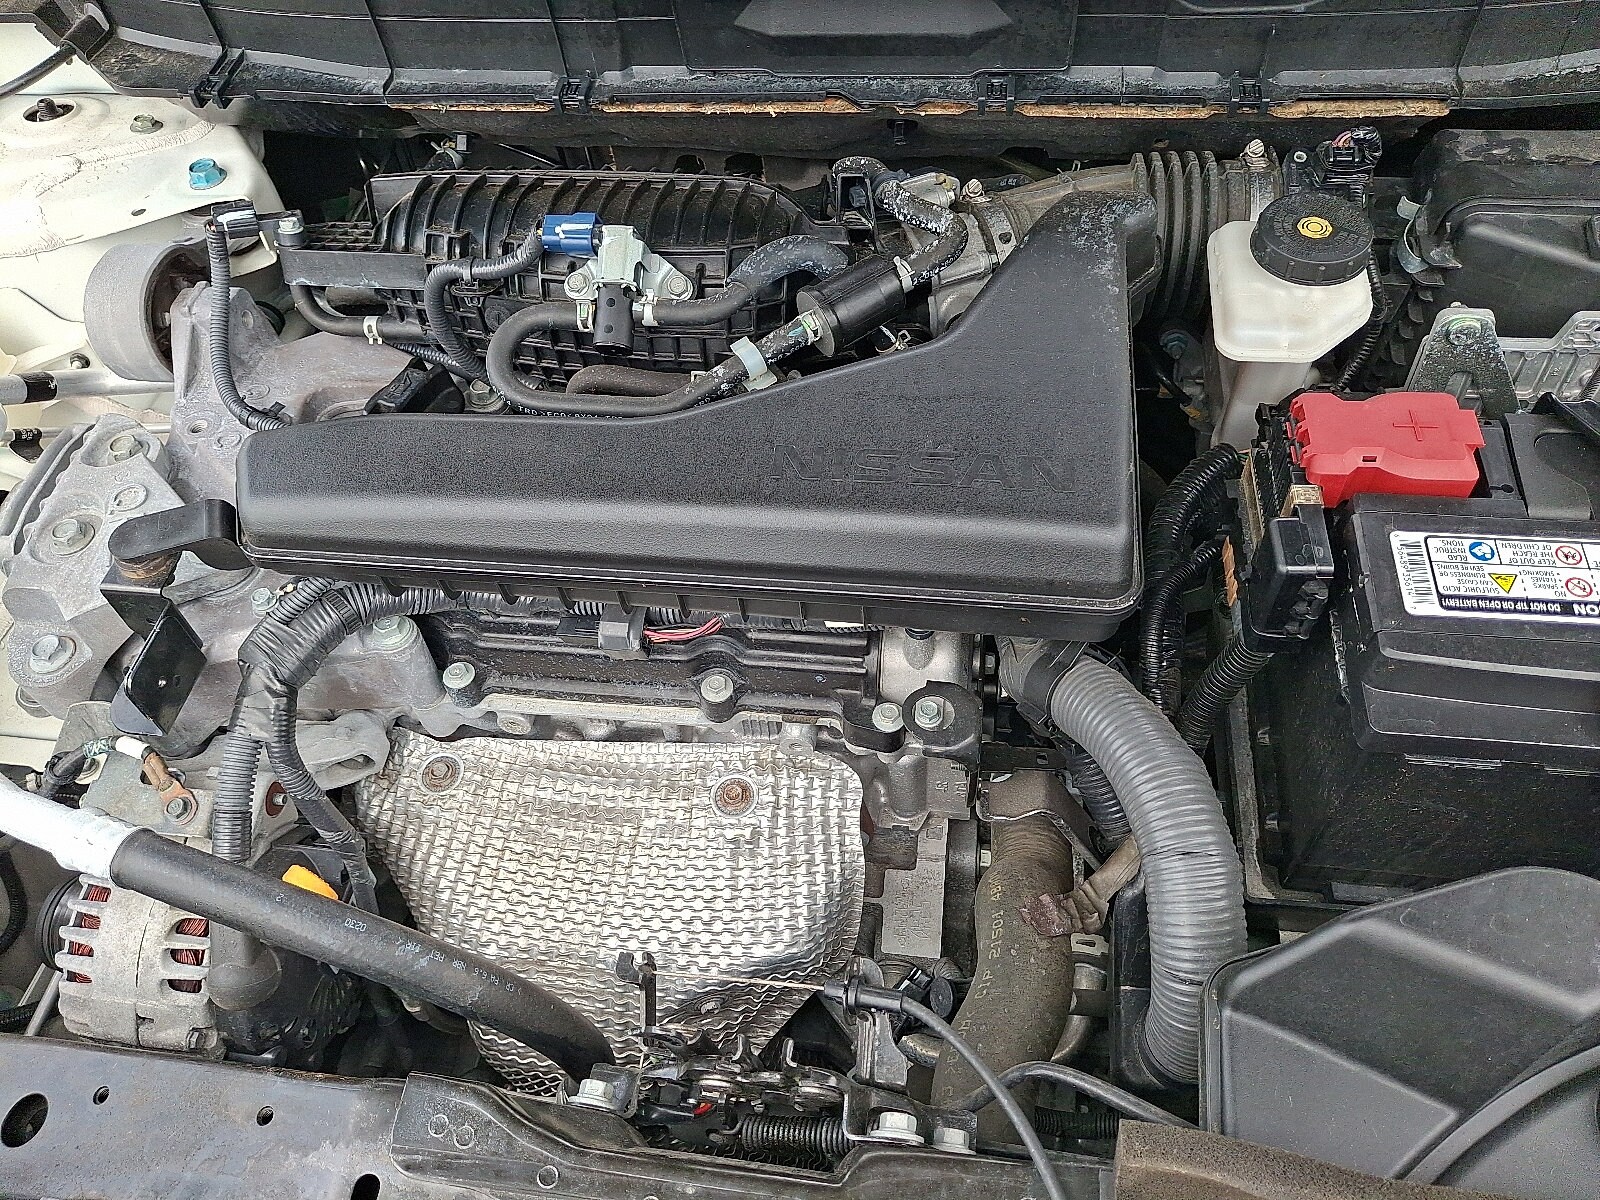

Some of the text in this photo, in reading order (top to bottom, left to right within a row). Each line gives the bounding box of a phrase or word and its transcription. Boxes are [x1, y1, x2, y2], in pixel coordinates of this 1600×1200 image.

[769, 444, 1077, 493] NISSAN
[1537, 558, 1557, 566] KEEP
[1554, 590, 1567, 598] NO
[1478, 599, 1501, 609] OPEN
[1502, 600, 1514, 609] OR
[1515, 600, 1528, 610] TIP
[1530, 601, 1547, 611] NOT
[1547, 602, 1561, 612] DO
[1572, 603, 1600, 616] ON
[344, 917, 367, 932] 0230
[988, 909, 1004, 960] 21501
